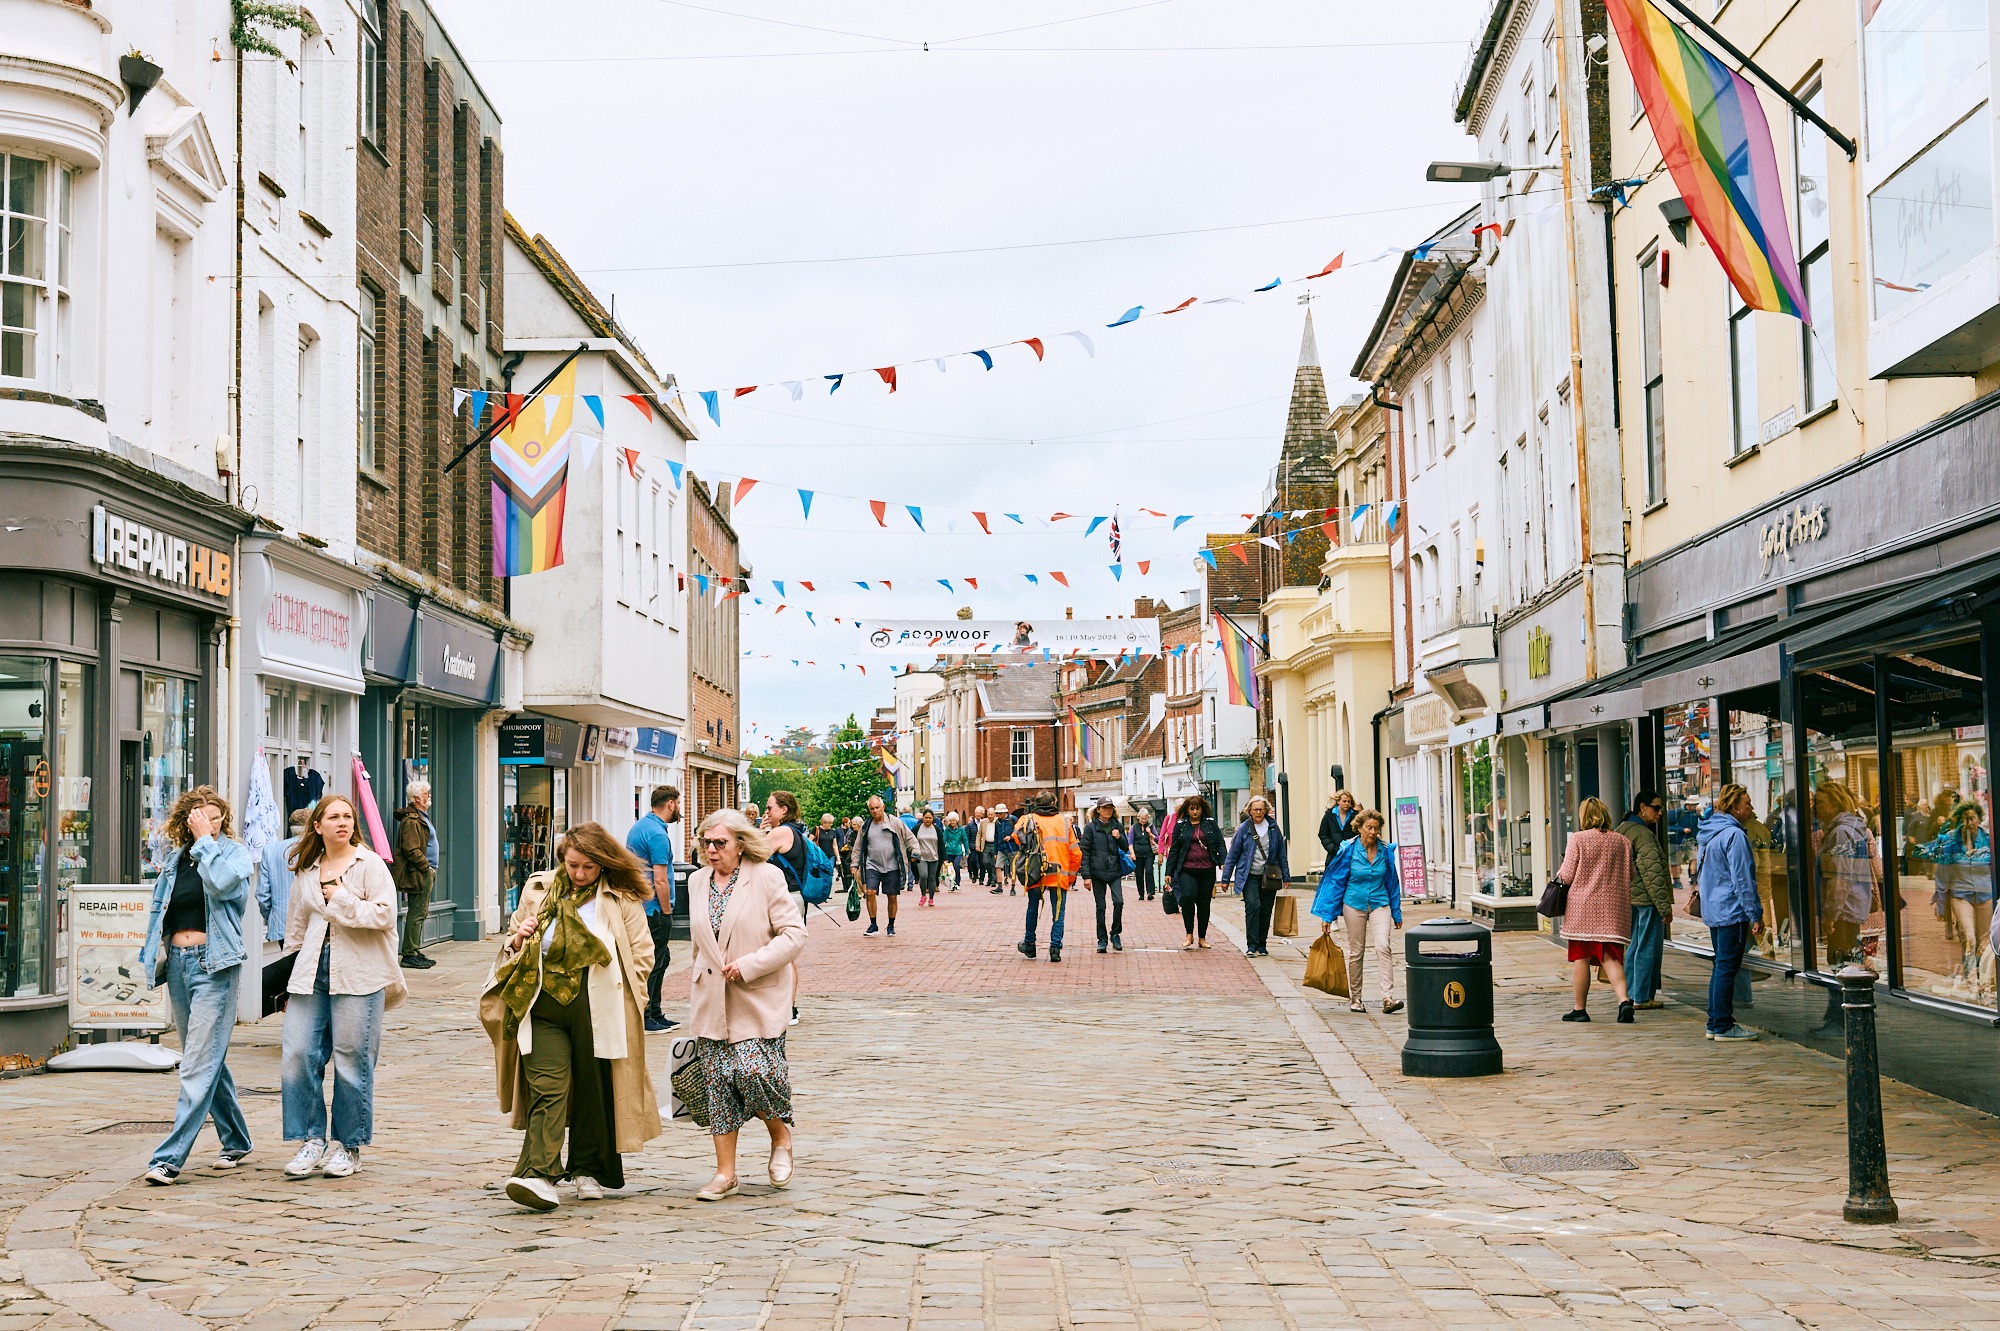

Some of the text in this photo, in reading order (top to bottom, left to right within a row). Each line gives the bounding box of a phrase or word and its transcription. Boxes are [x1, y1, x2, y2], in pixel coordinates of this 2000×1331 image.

[1759, 501, 1824, 579] Gold Arts
[107, 513, 231, 598] REPAIR HUB
[1080, 634, 1096, 643] May
[449, 651, 476, 681] nationwide
[1403, 859, 1423, 868] BUY 3
[1404, 868, 1424, 878] GET 3
[1405, 878, 1424, 888] FREE
[79, 902, 144, 911] REPAIR HUB
[80, 930, 94, 938] We
[96, 931, 125, 940] Repair
[130, 1010, 148, 1018] Wait
